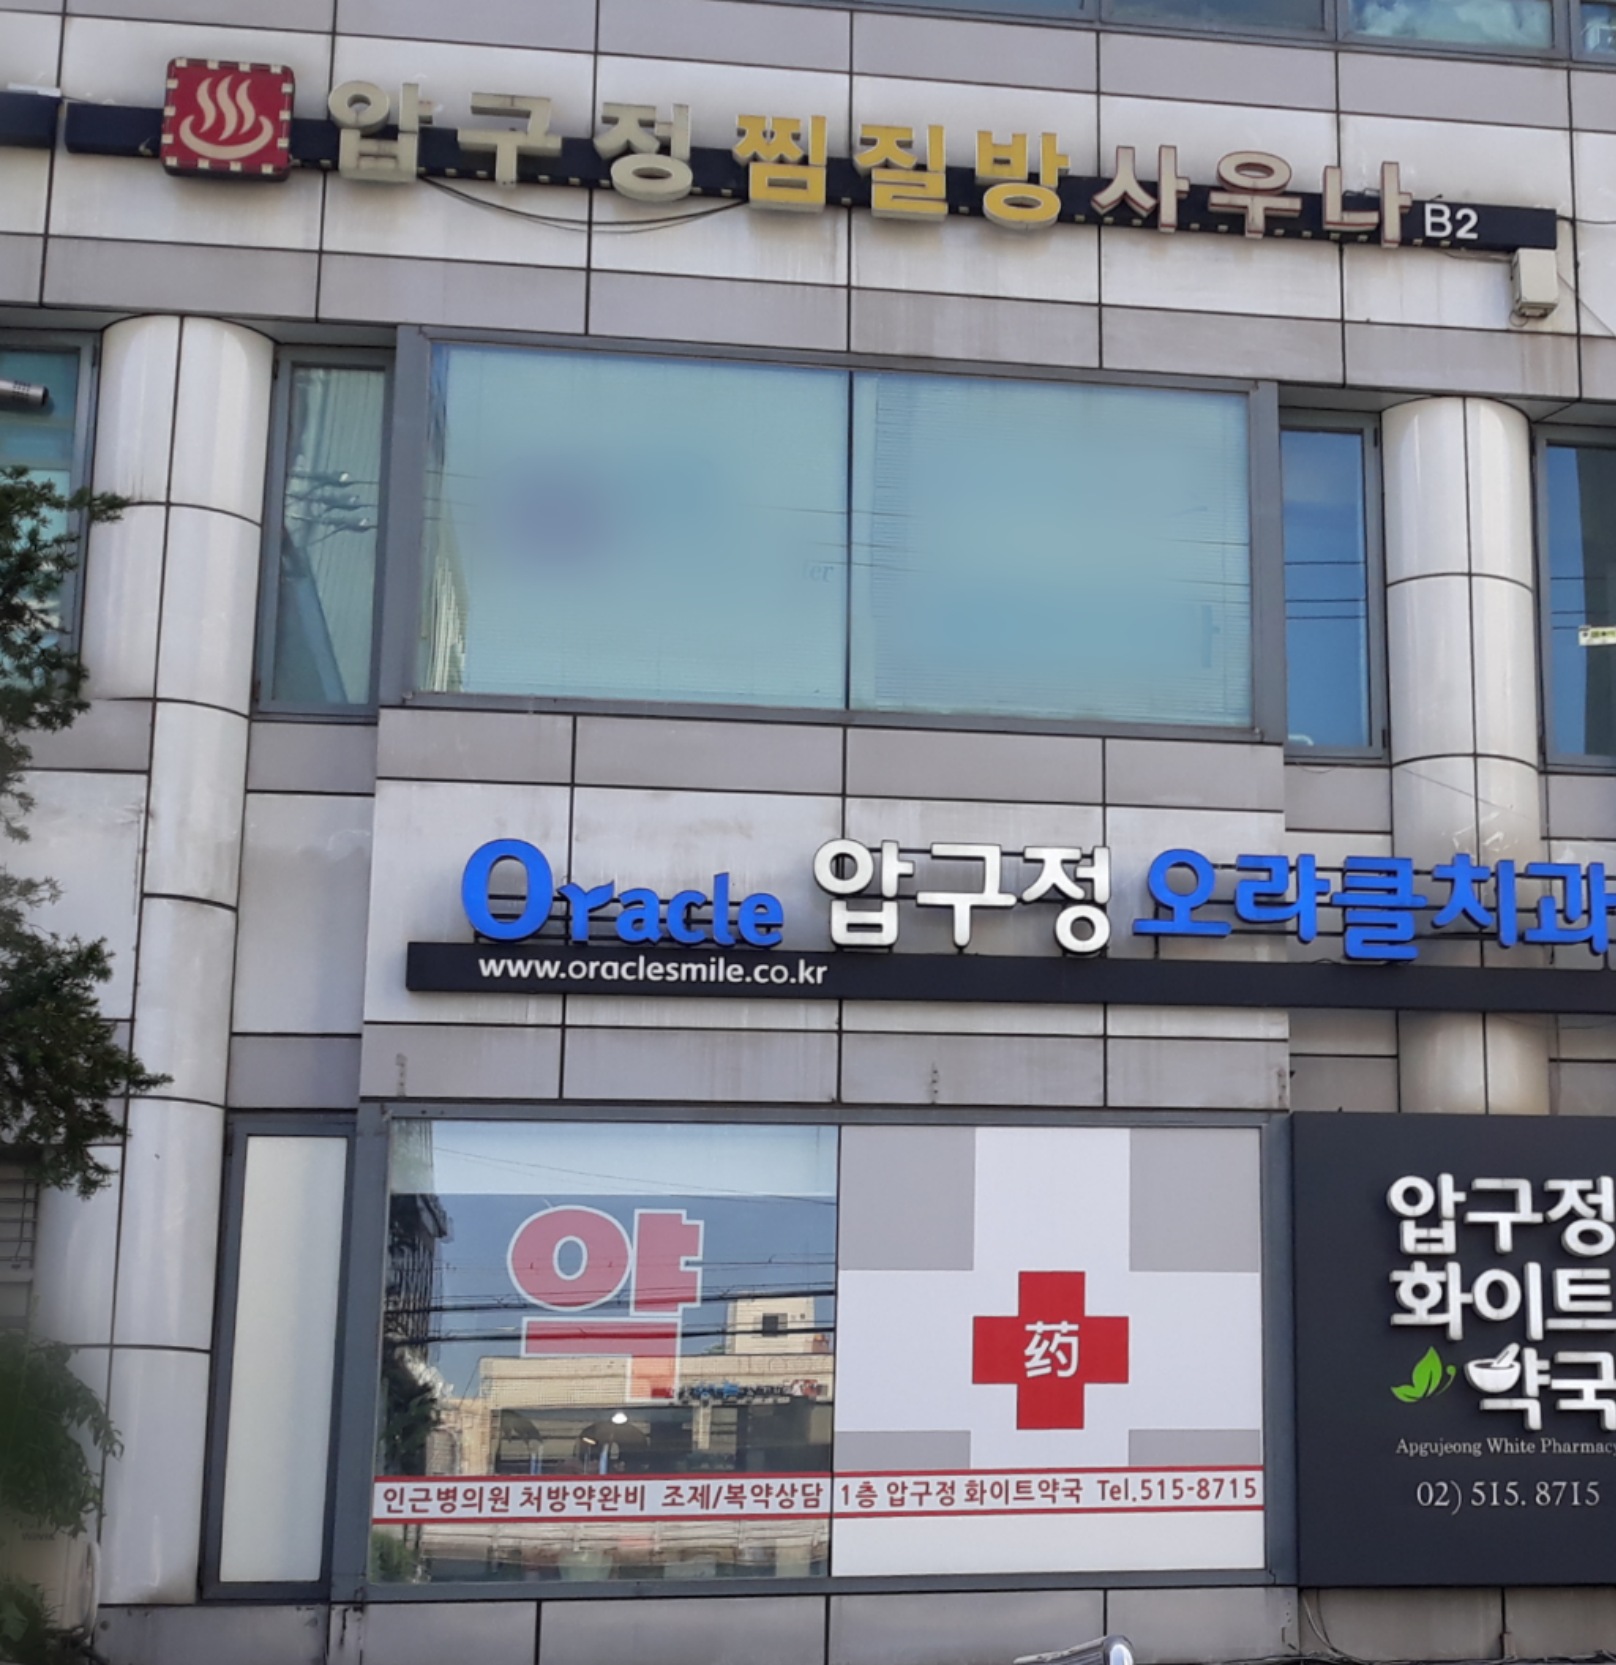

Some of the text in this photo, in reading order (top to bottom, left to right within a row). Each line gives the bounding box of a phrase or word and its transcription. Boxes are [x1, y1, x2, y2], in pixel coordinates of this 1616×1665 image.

[328, 79, 1479, 248] 압구정 찜질방 사우나 B2
[461, 837, 784, 947] Oracle
[812, 838, 1113, 955] 압구정
[478, 954, 829, 986] www.oraclesmile.co.kr
[1386, 1172, 1616, 1257] 압구정
[506, 1204, 705, 1401] 약
[1395, 1438, 1483, 1459] Apgujeong
[1486, 1437, 1536, 1455] White
[383, 1476, 1257, 1514] 인근병의원 처방약완비 조제/복약상담 1층 압구정 화이트약국 Tel.515-8715
[1416, 1480, 1463, 1515] 02)
[1536, 1480, 1600, 1507] 8715
